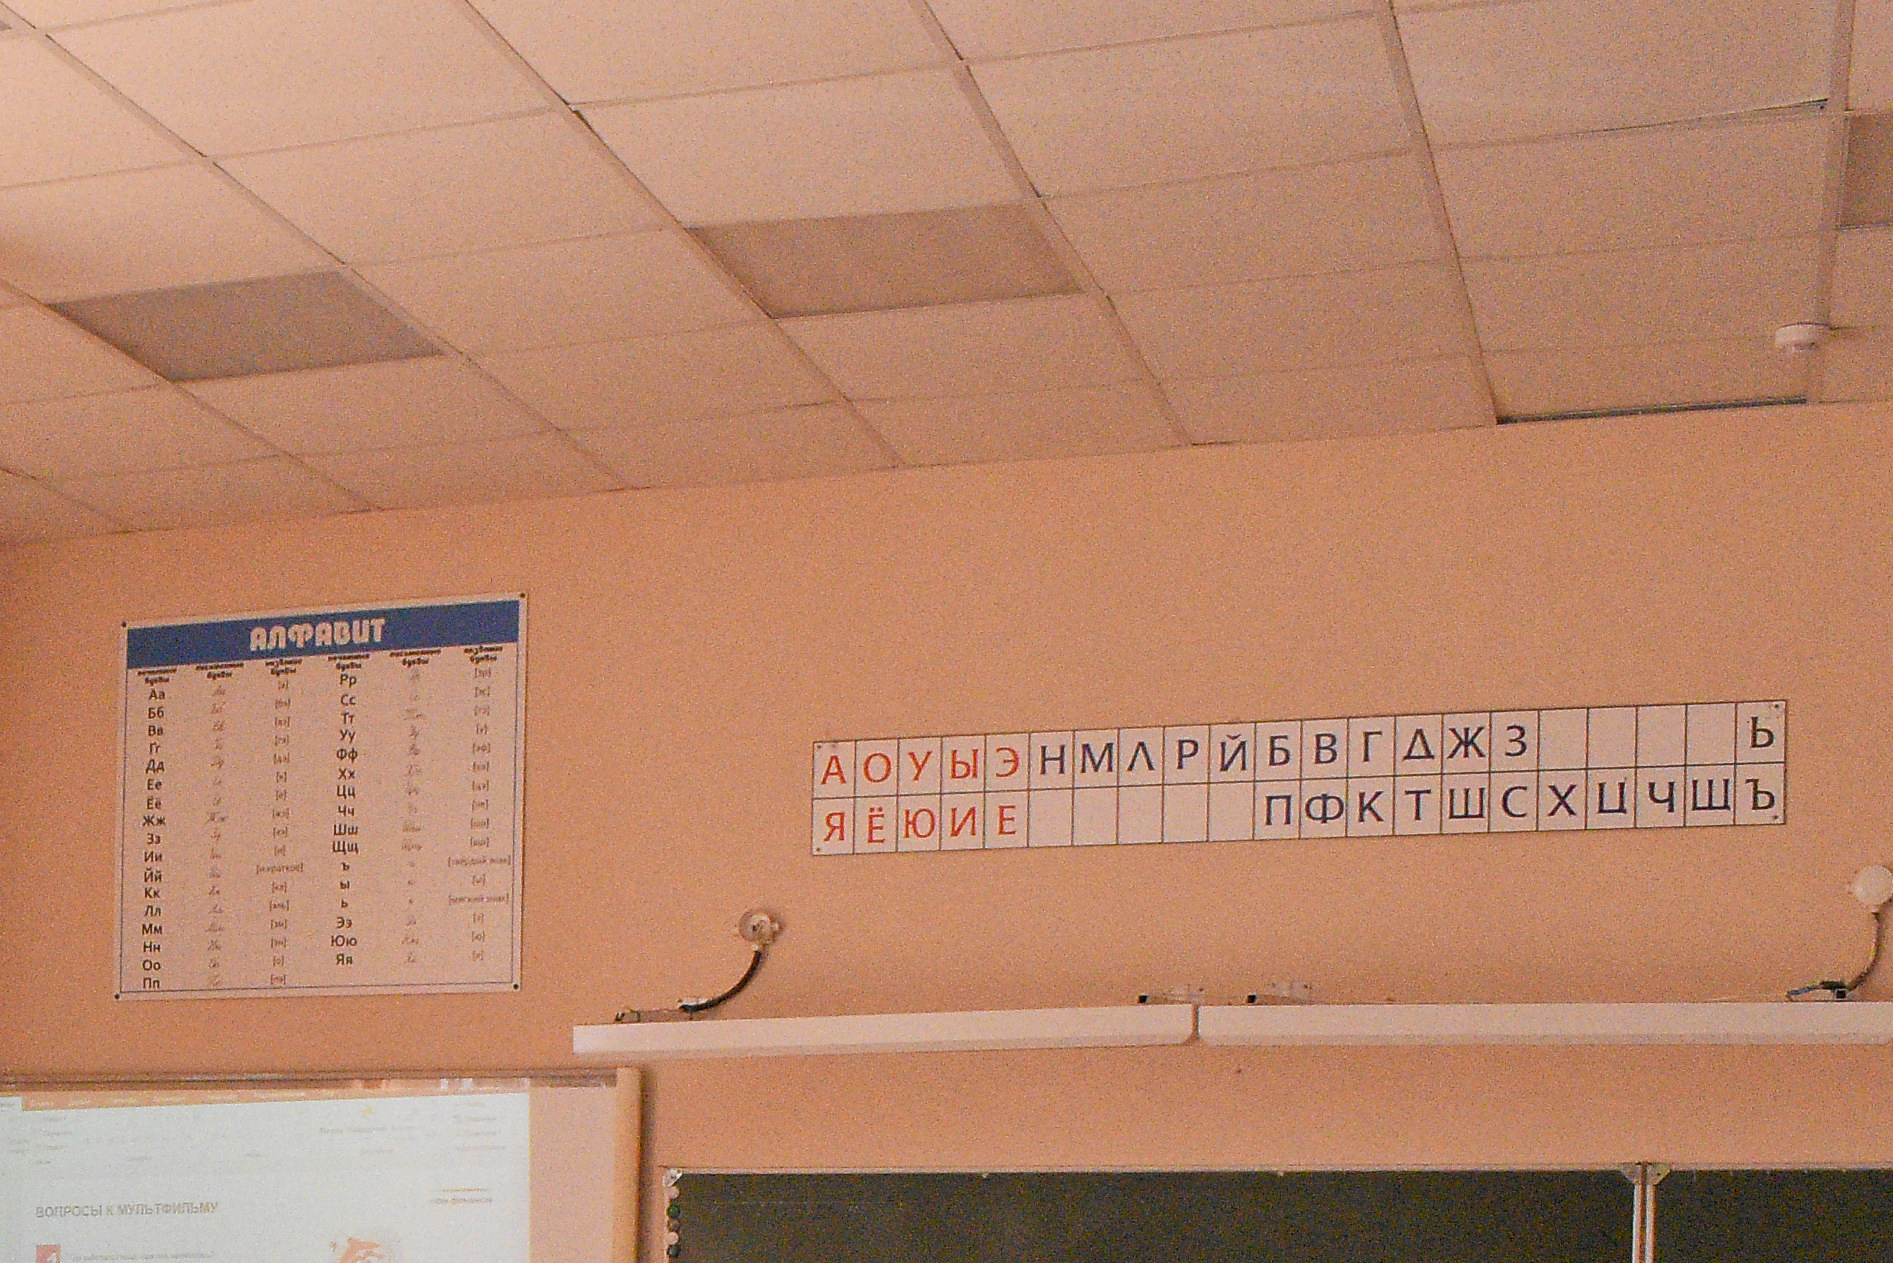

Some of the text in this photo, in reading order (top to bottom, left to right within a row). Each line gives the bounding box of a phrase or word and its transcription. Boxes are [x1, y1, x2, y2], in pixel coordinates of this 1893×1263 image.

[250, 619, 385, 651] АЛФАВИТ
[339, 673, 358, 689] Рр
[148, 688, 166, 701] Аа
[340, 693, 357, 707] Сс
[147, 705, 165, 720] Бб
[340, 711, 355, 725] Тт
[147, 724, 164, 737] Вв
[339, 729, 356, 745] Уу
[149, 741, 162, 755] Гг
[820, 755, 846, 785] А
[863, 752, 892, 783] О
[908, 750, 932, 782] У
[950, 749, 978, 780] Ы
[995, 747, 1019, 778] Э
[1039, 744, 1065, 776] Н
[1079, 742, 1114, 775] М
[1126, 741, 1155, 772] Л
[1176, 739, 1199, 770] Р
[1219, 733, 1247, 772] Й
[1268, 735, 1290, 767] Б
[1314, 733, 1337, 765] В
[1362, 730, 1383, 763] Г
[1402, 728, 1435, 761] Д
[1447, 726, 1485, 760] Ж
[1504, 724, 1527, 757] З
[336, 747, 359, 764] Фф
[145, 758, 165, 775] Дд
[337, 767, 355, 780] Хх
[146, 778, 163, 791] Ее
[336, 784, 356, 800] Цц
[337, 804, 355, 817] Чч
[823, 811, 845, 842] Я
[867, 807, 885, 844] Ё
[903, 808, 936, 839] Ю
[950, 807, 976, 838] И
[998, 805, 1016, 836] Е
[1265, 795, 1292, 826] П
[1304, 793, 1344, 824] Ф
[1358, 791, 1384, 823] К
[1404, 789, 1432, 821] Т
[1448, 787, 1485, 820] Ш
[1501, 785, 1528, 818] С
[1547, 784, 1576, 817] Х
[1648, 781, 1675, 813] Ч
[1745, 778, 1775, 811] Ъ
[142, 814, 166, 827] Жж
[333, 823, 359, 836] Шш
[146, 832, 161, 846] Зз
[331, 840, 359, 856] Щщ
[143, 850, 163, 863] Ии
[143, 866, 163, 883] Йй
[144, 886, 160, 899] Кк
[143, 904, 162, 917] Лл
[141, 923, 163, 935] Мм
[336, 915, 353, 929] Ээ
[142, 941, 161, 953] Нн
[330, 934, 358, 948] Юю
[141, 958, 162, 972] Оо
[335, 952, 354, 966] Яя
[142, 976, 161, 989] Пп
[35, 1205, 102, 1218] ВОПРОСЫ
[117, 1202, 218, 1216] МУЛЬТФИЛЬМУ
